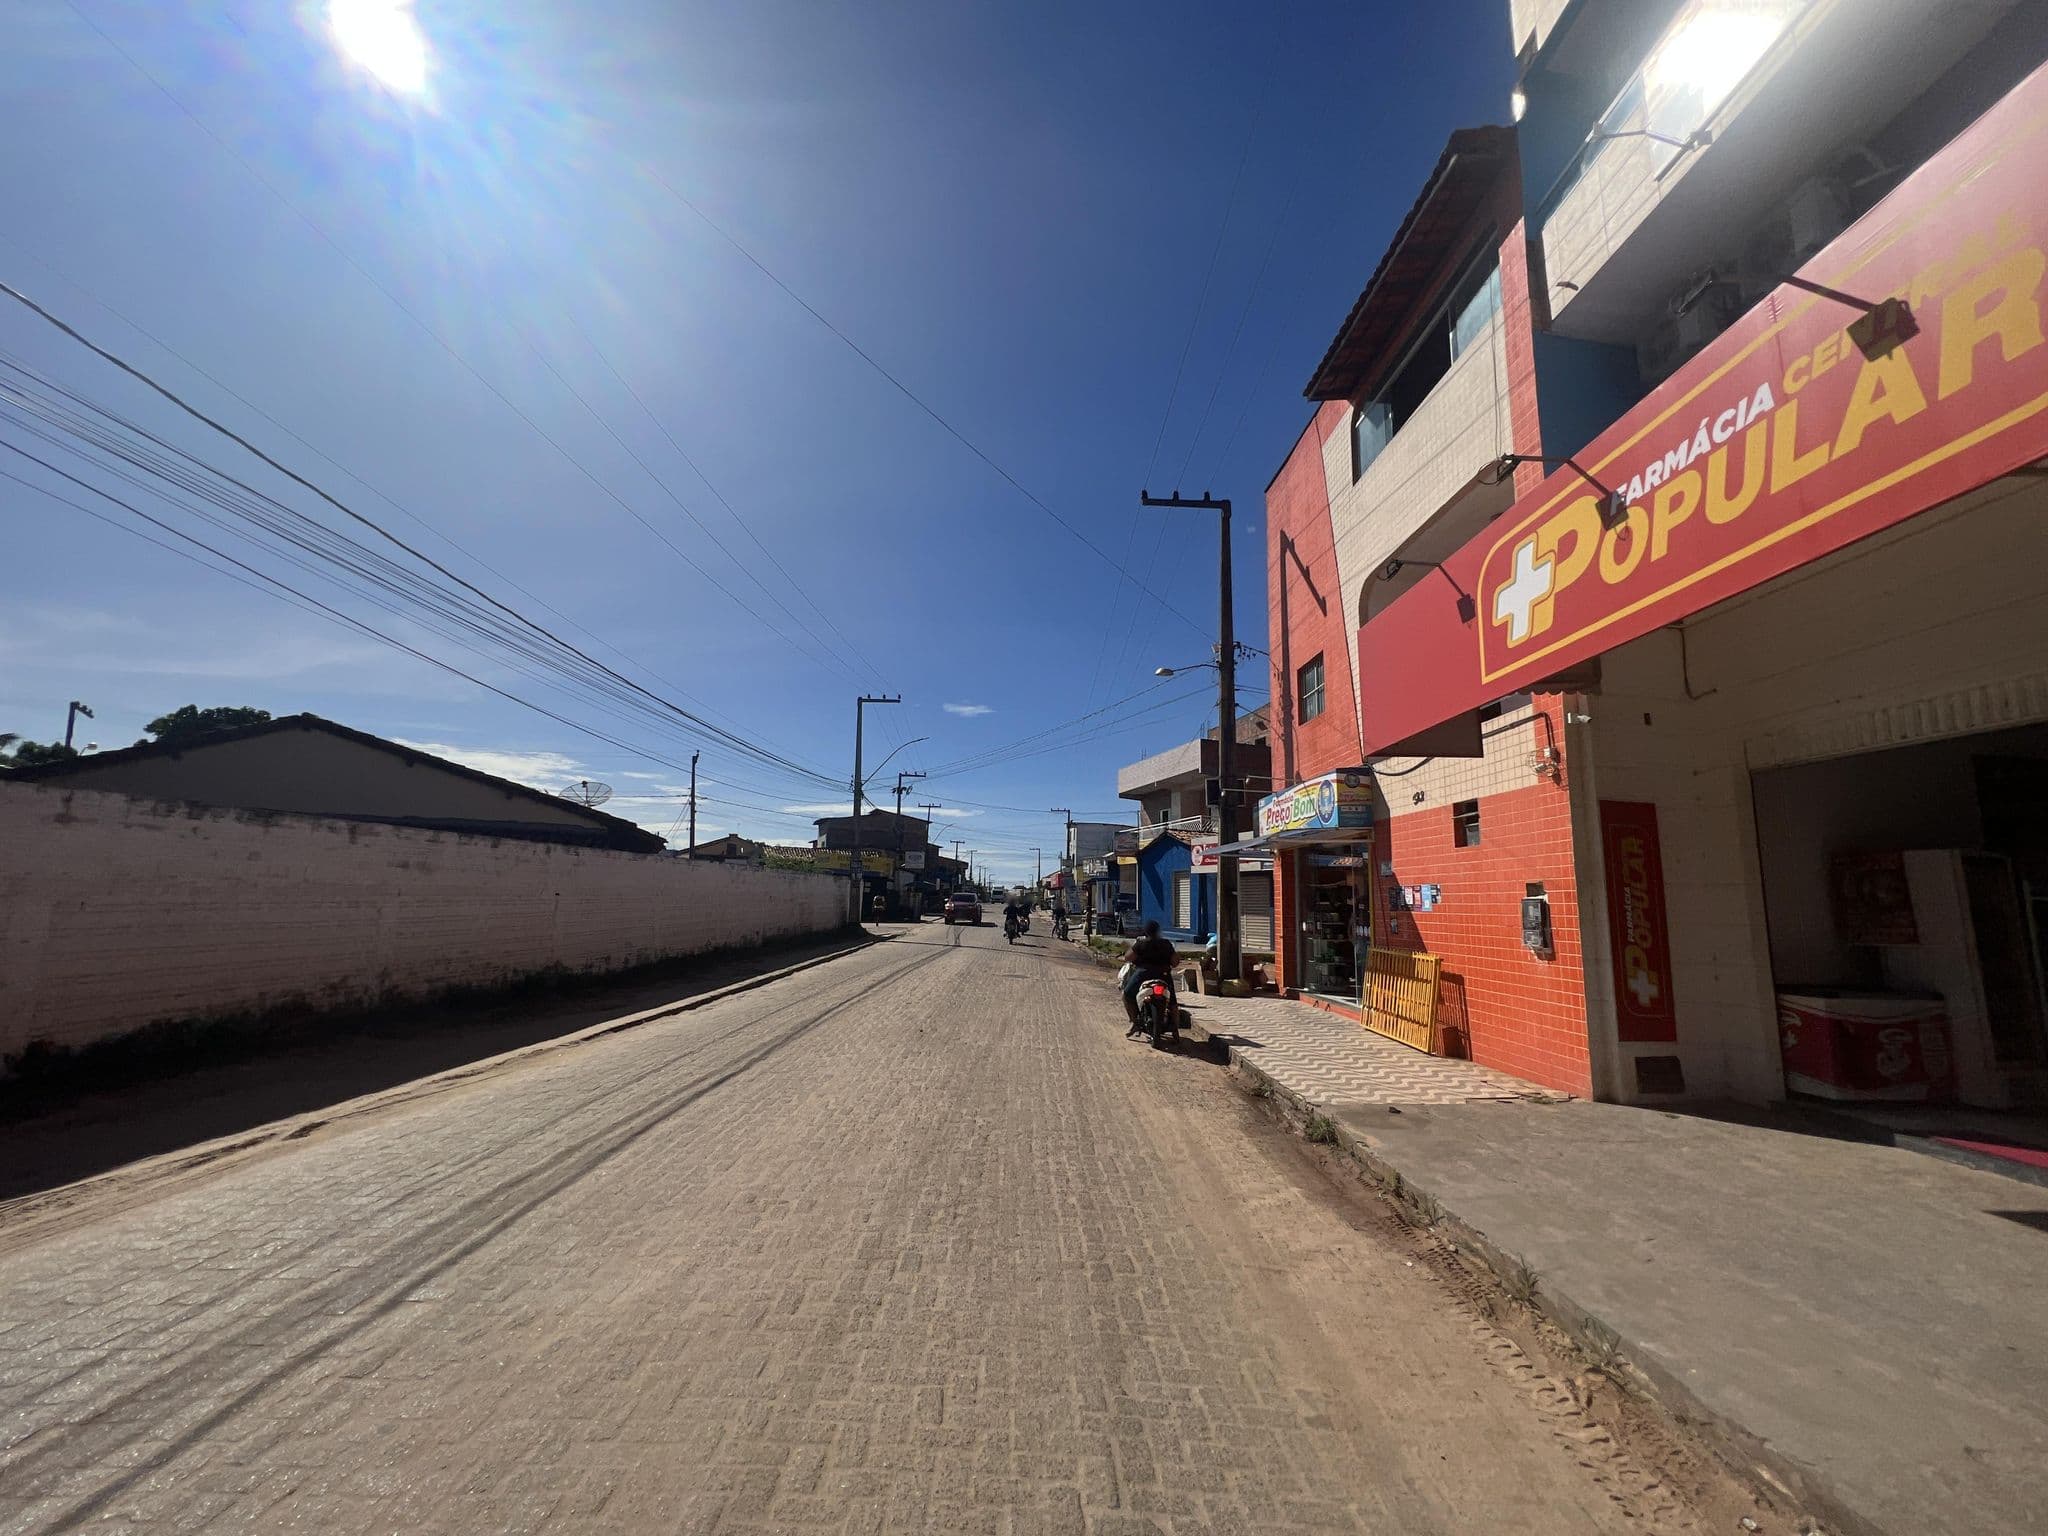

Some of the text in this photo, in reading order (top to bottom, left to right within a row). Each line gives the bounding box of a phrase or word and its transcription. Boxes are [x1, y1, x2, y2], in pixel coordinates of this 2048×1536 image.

[1530, 247, 2046, 638] POPULAR
[1611, 382, 1775, 511] FARMÁCIA
[1266, 806, 1291, 830] Preço
[1293, 797, 1316, 817] Bom
